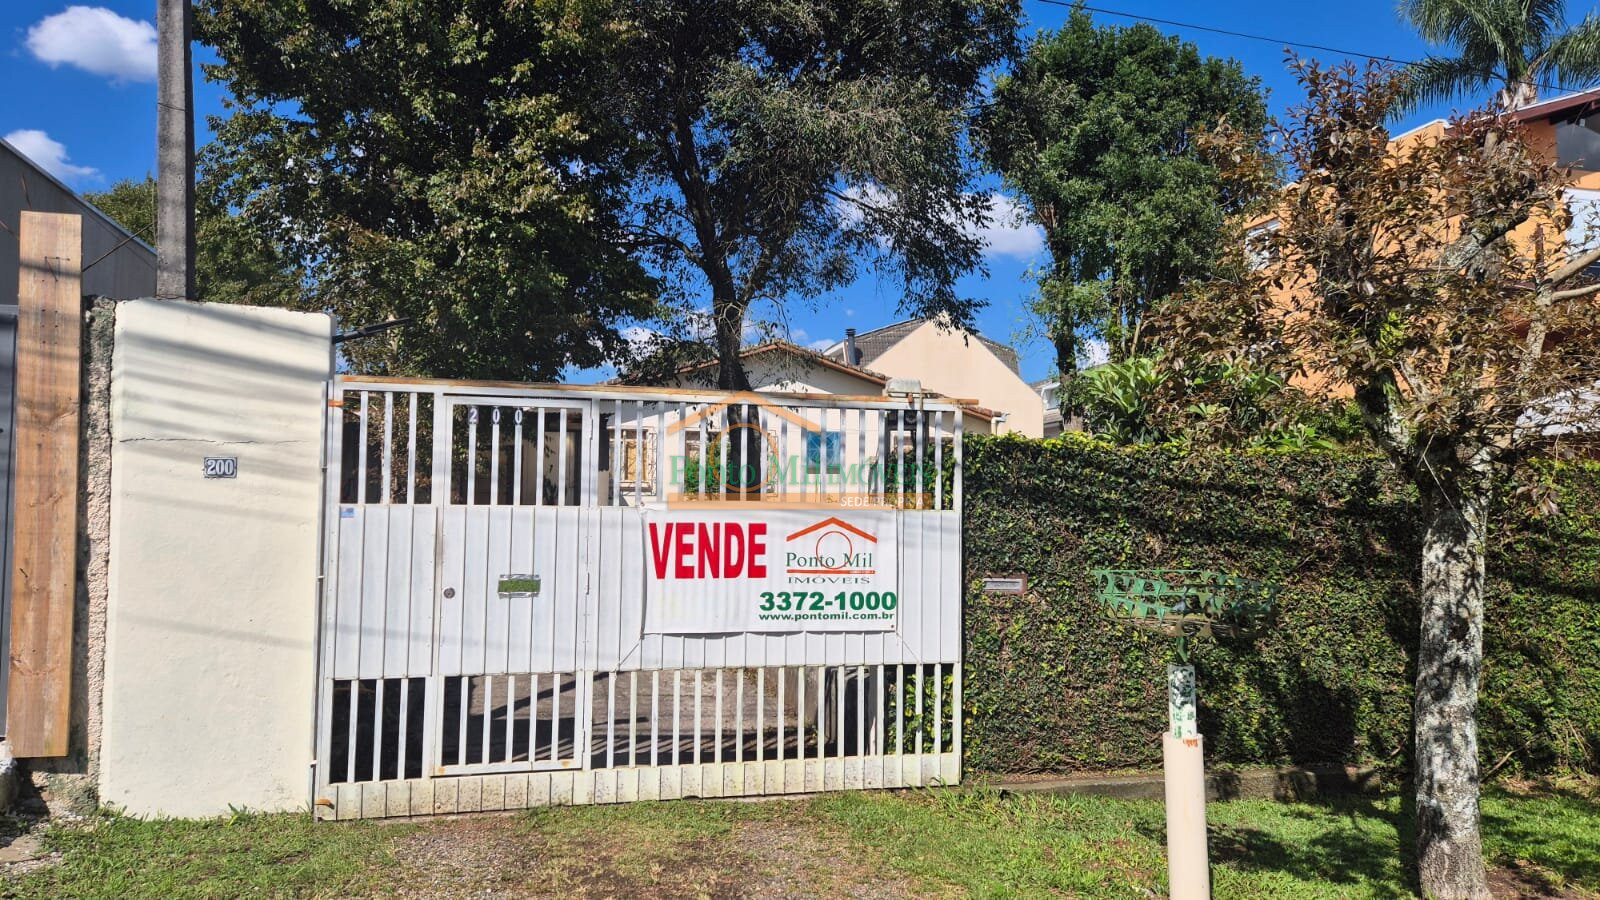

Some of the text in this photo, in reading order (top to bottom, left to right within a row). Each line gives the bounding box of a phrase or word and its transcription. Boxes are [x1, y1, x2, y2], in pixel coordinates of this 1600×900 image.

[206, 459, 234, 475] 200
[649, 522, 767, 579] VENDE
[786, 552, 873, 568] Ponto Mil
[787, 576, 870, 585] IMÓVEIS
[759, 591, 897, 611] 3372-1000
[758, 612, 895, 622] www.pontomil.com.br
